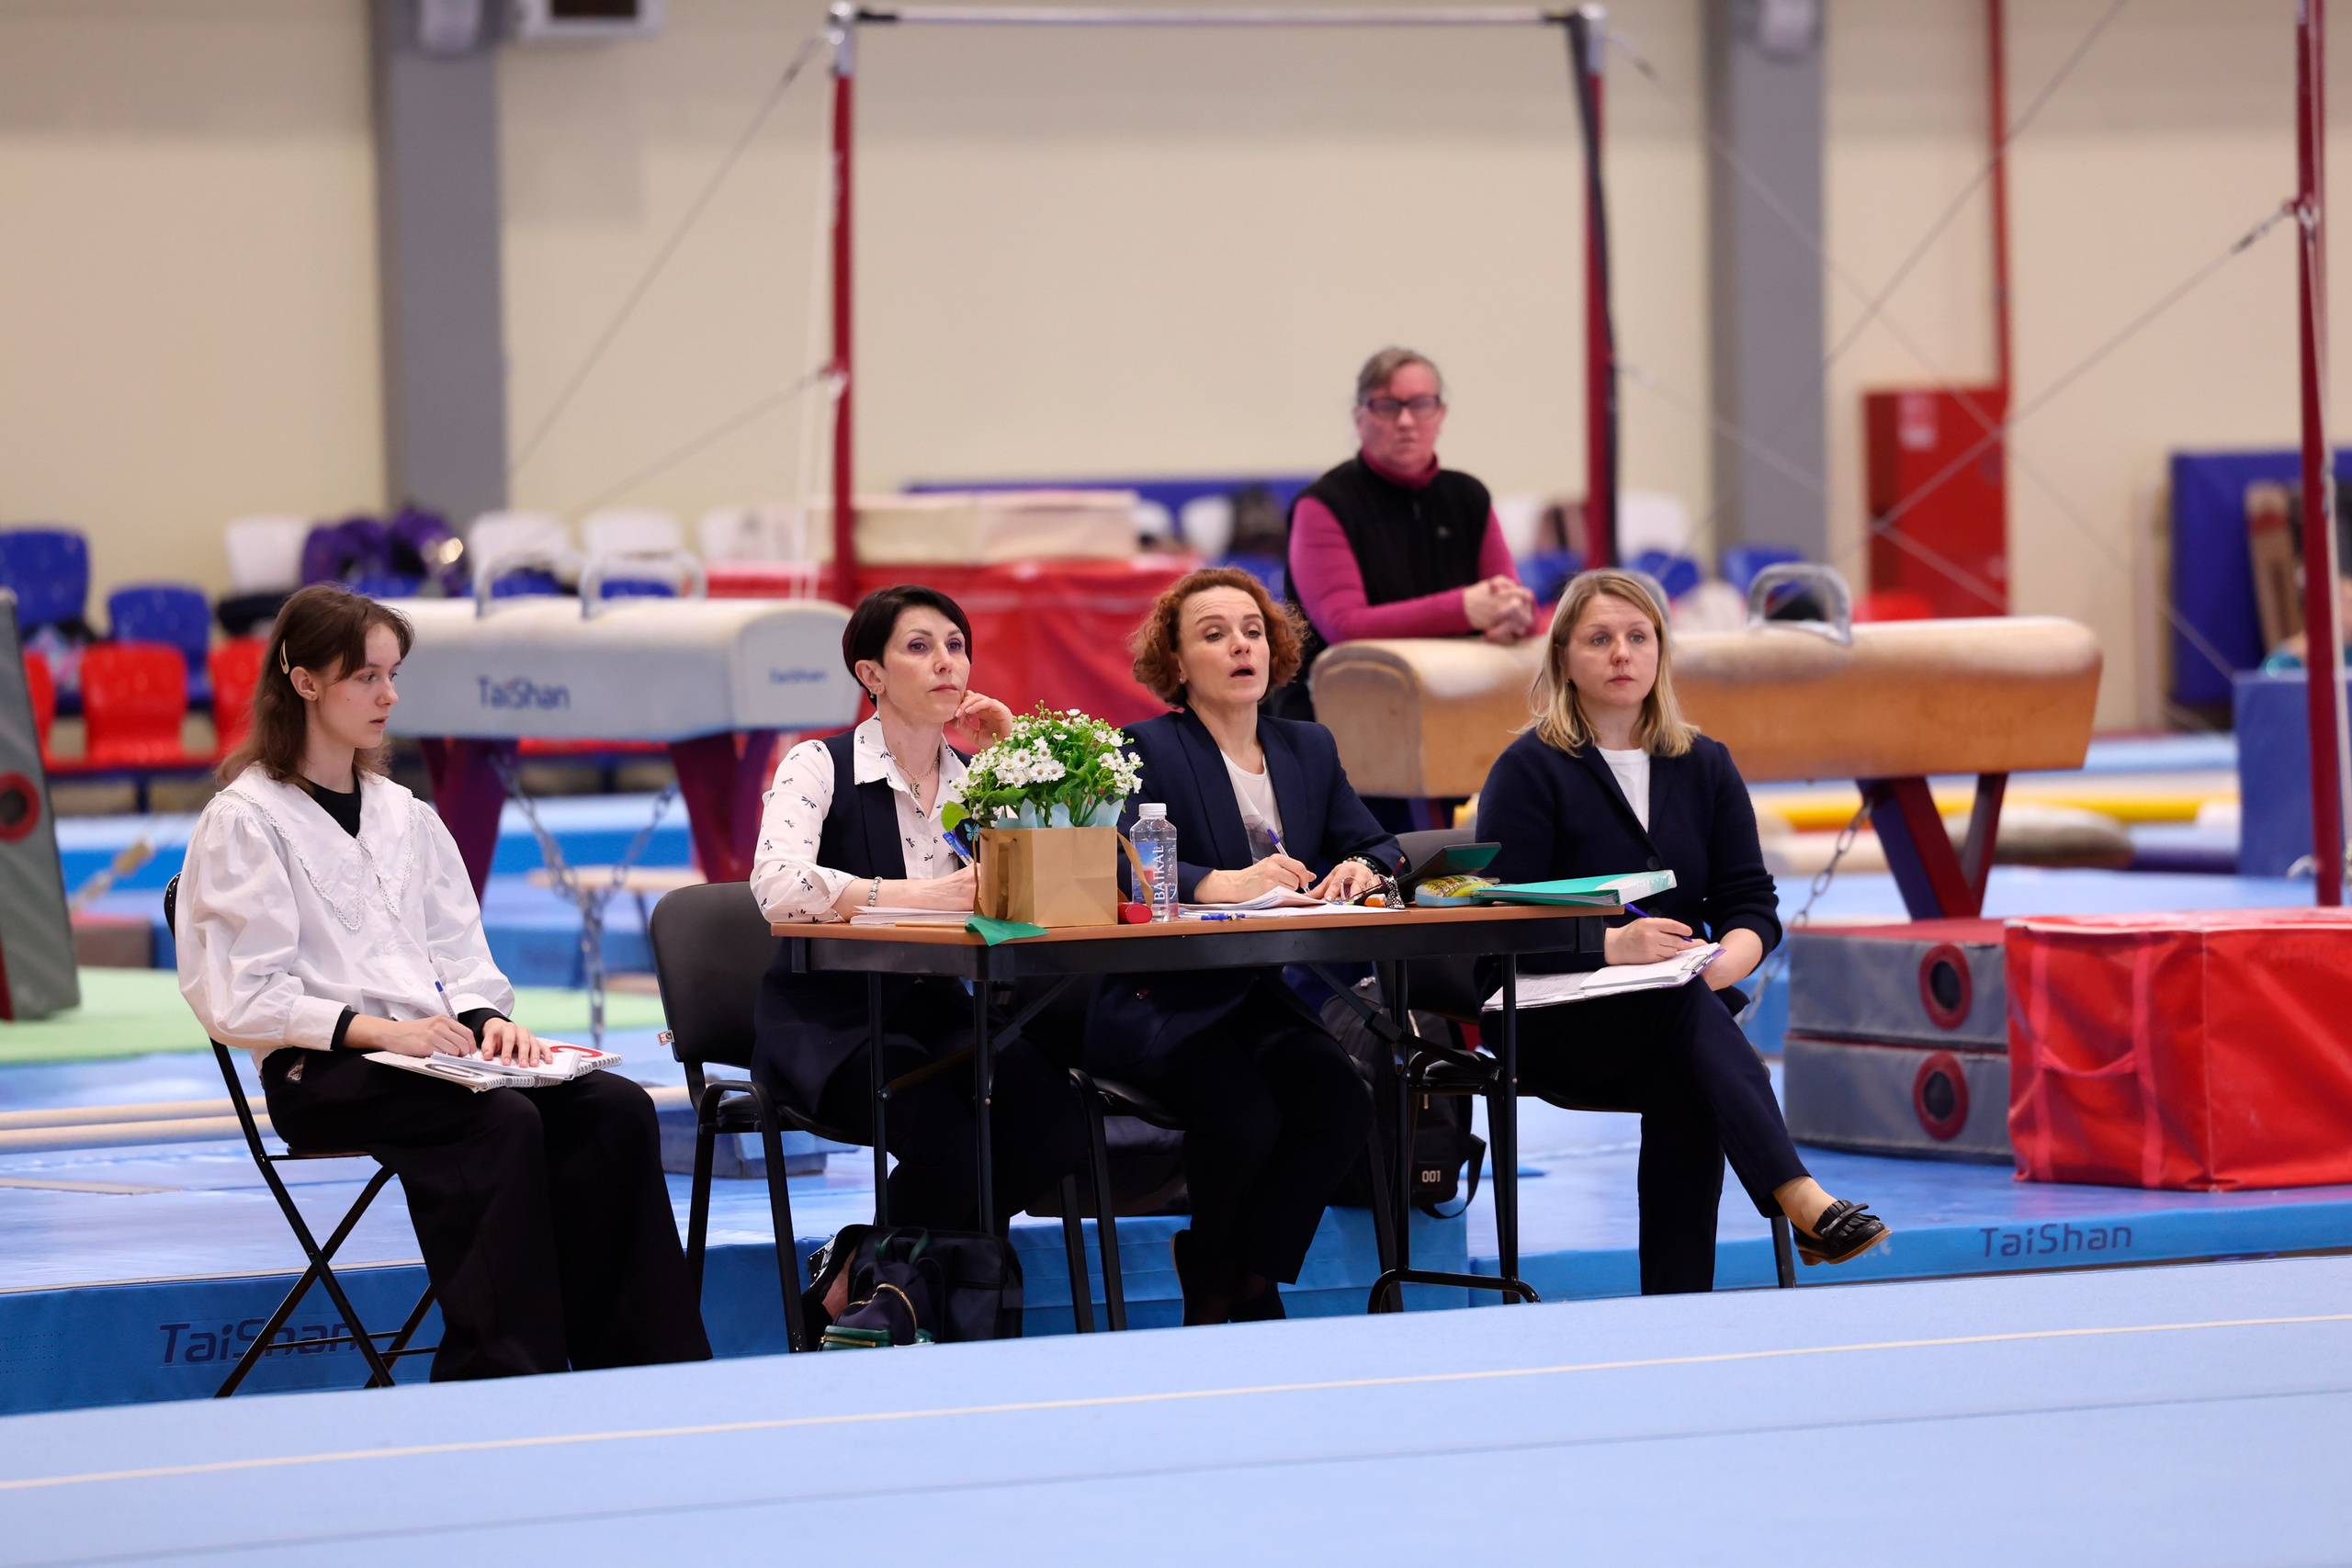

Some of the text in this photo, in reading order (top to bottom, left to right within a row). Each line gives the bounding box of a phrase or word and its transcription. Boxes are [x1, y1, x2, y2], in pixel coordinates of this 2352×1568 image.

[476, 675, 571, 709] TaiShan
[1152, 845, 1166, 901] BAIKAL
[1421, 1170, 1441, 1182] 001
[1980, 1223, 2132, 1258] TaiShan
